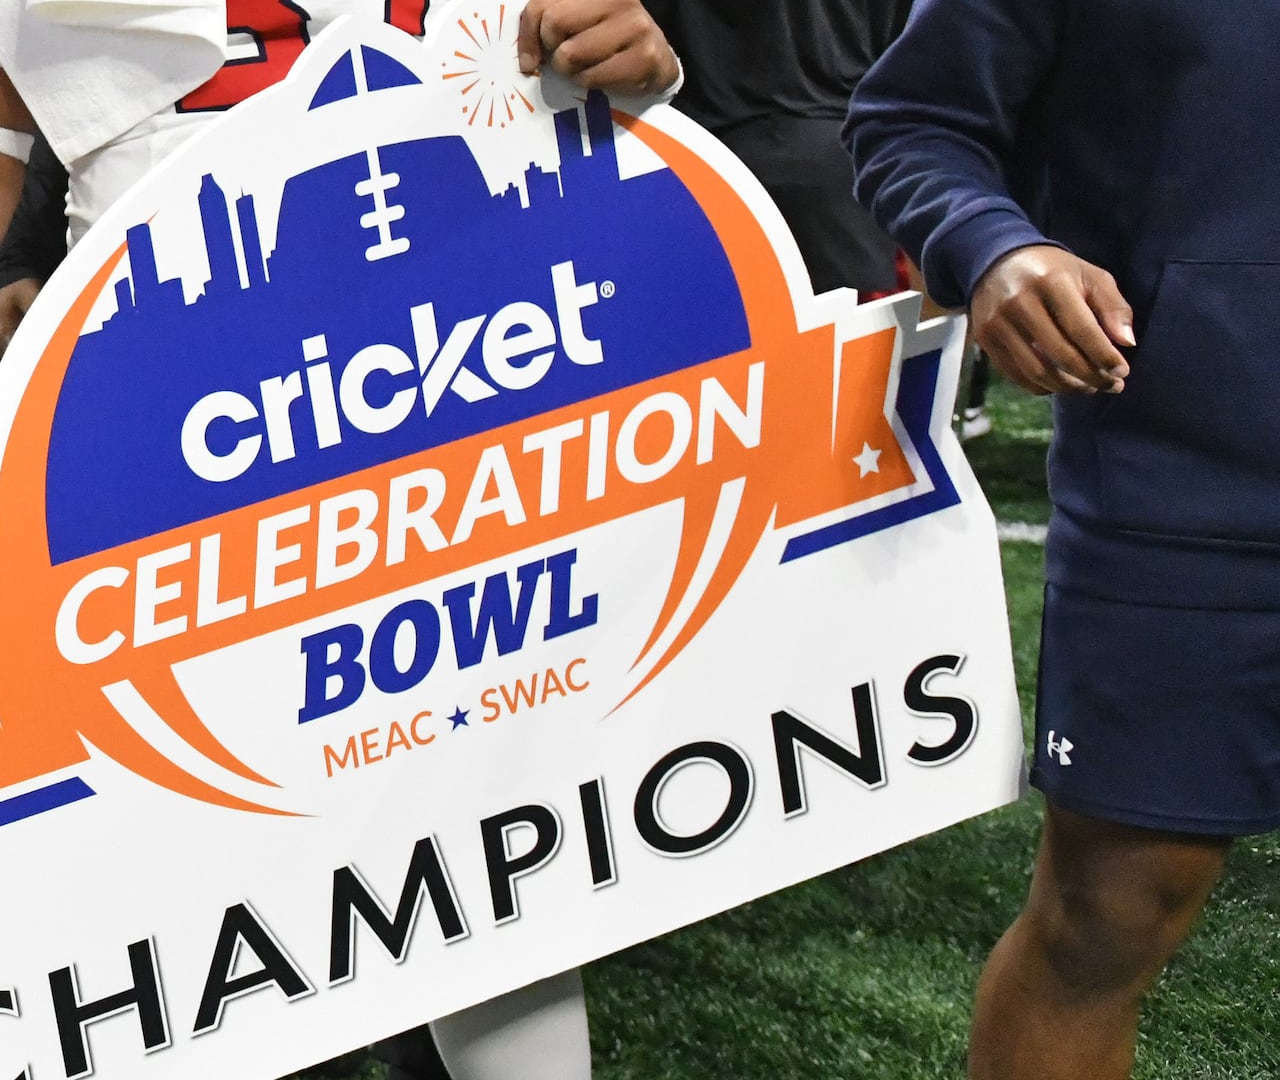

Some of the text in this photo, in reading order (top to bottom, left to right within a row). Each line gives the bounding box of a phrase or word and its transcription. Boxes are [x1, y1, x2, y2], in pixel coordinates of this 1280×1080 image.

[53, 363, 766, 667] CELEBRATION
[296, 547, 600, 726] BOWL
[323, 657, 590, 778] MEAC SWAC
